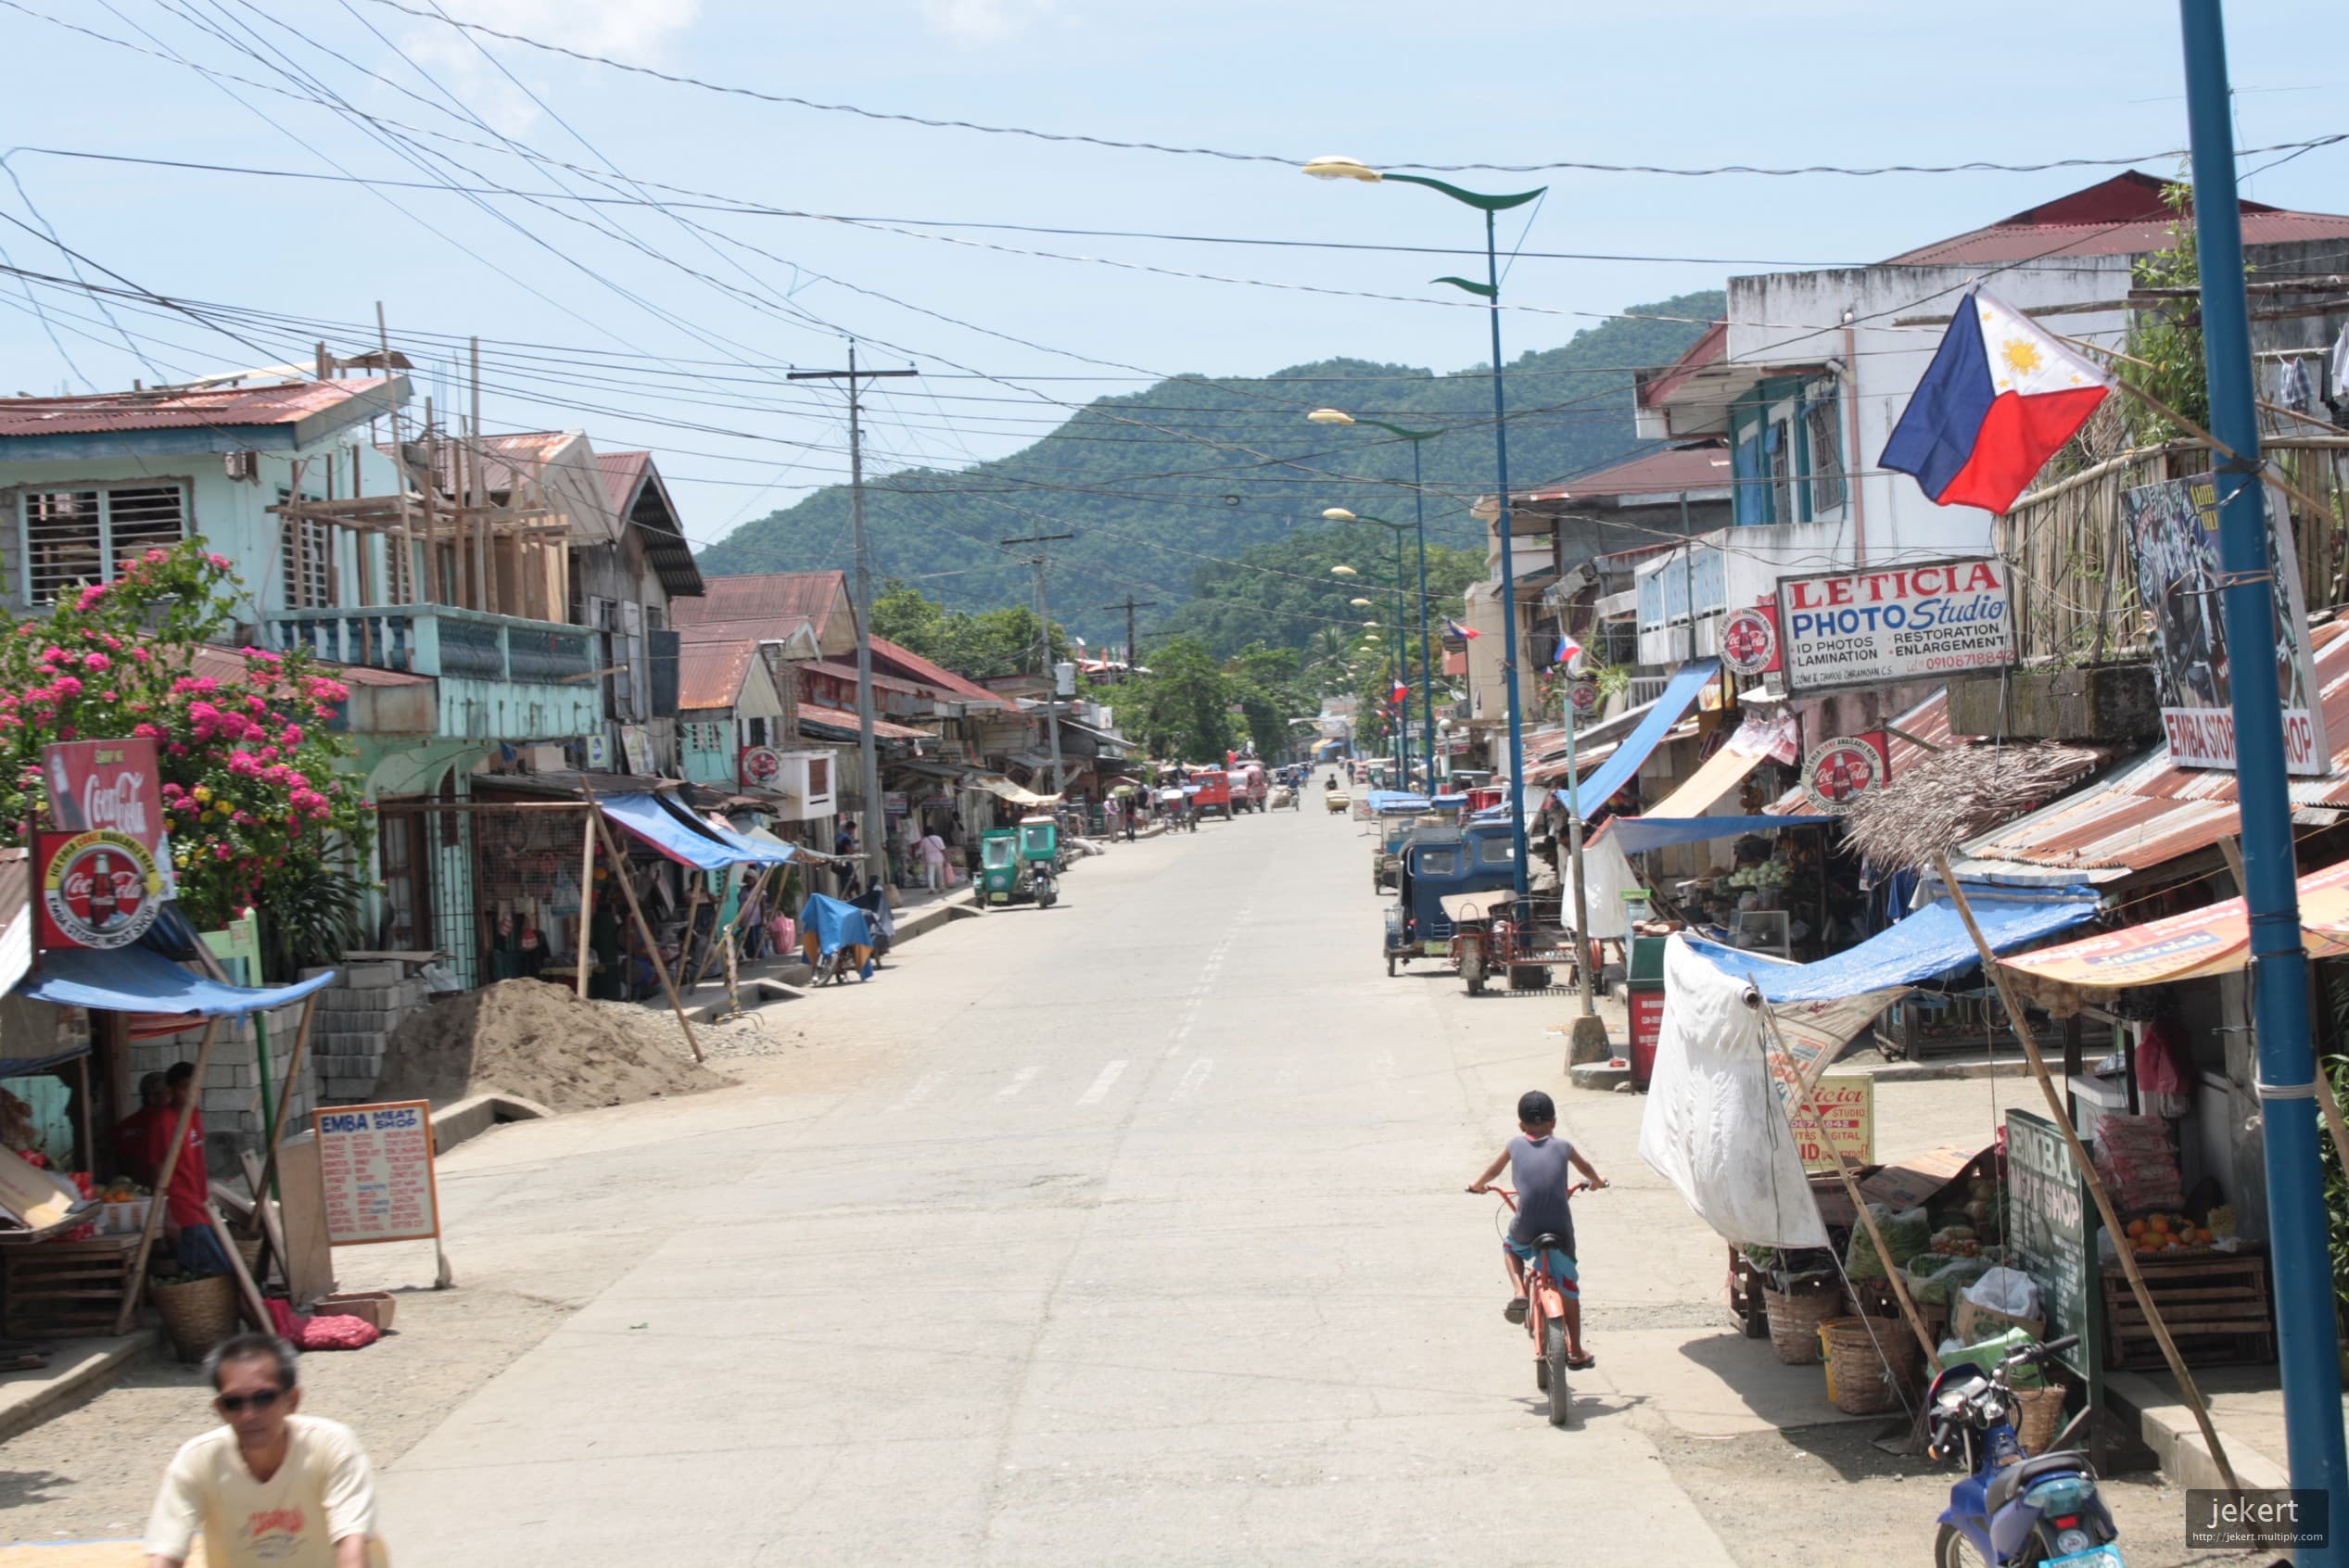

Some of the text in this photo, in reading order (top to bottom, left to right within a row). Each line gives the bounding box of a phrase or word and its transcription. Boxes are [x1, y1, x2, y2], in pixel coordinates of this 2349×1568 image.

[1789, 563, 2002, 610] LETICIA
[1792, 595, 2007, 639] PHOTO Studio
[1727, 630, 1766, 650] CocCola
[1894, 623, 2000, 644] RESTORATION
[1797, 637, 1873, 654] ID PHOTOS
[1895, 636, 2008, 657] ENLARGEMENT
[1797, 649, 1878, 667] LAMINATION
[2165, 714, 2312, 764] EMBA STOR HOP
[1816, 761, 1871, 788] CocCola
[65, 871, 143, 901] CocCola
[321, 1109, 415, 1133] EMBA MEAT
[1832, 1108, 1865, 1118] STUDIO
[375, 1119, 417, 1130] SHOP
[1800, 1144, 1821, 1160] ID
[2010, 1126, 2077, 1188] EMBA
[2044, 1180, 2080, 1230] SHOP
